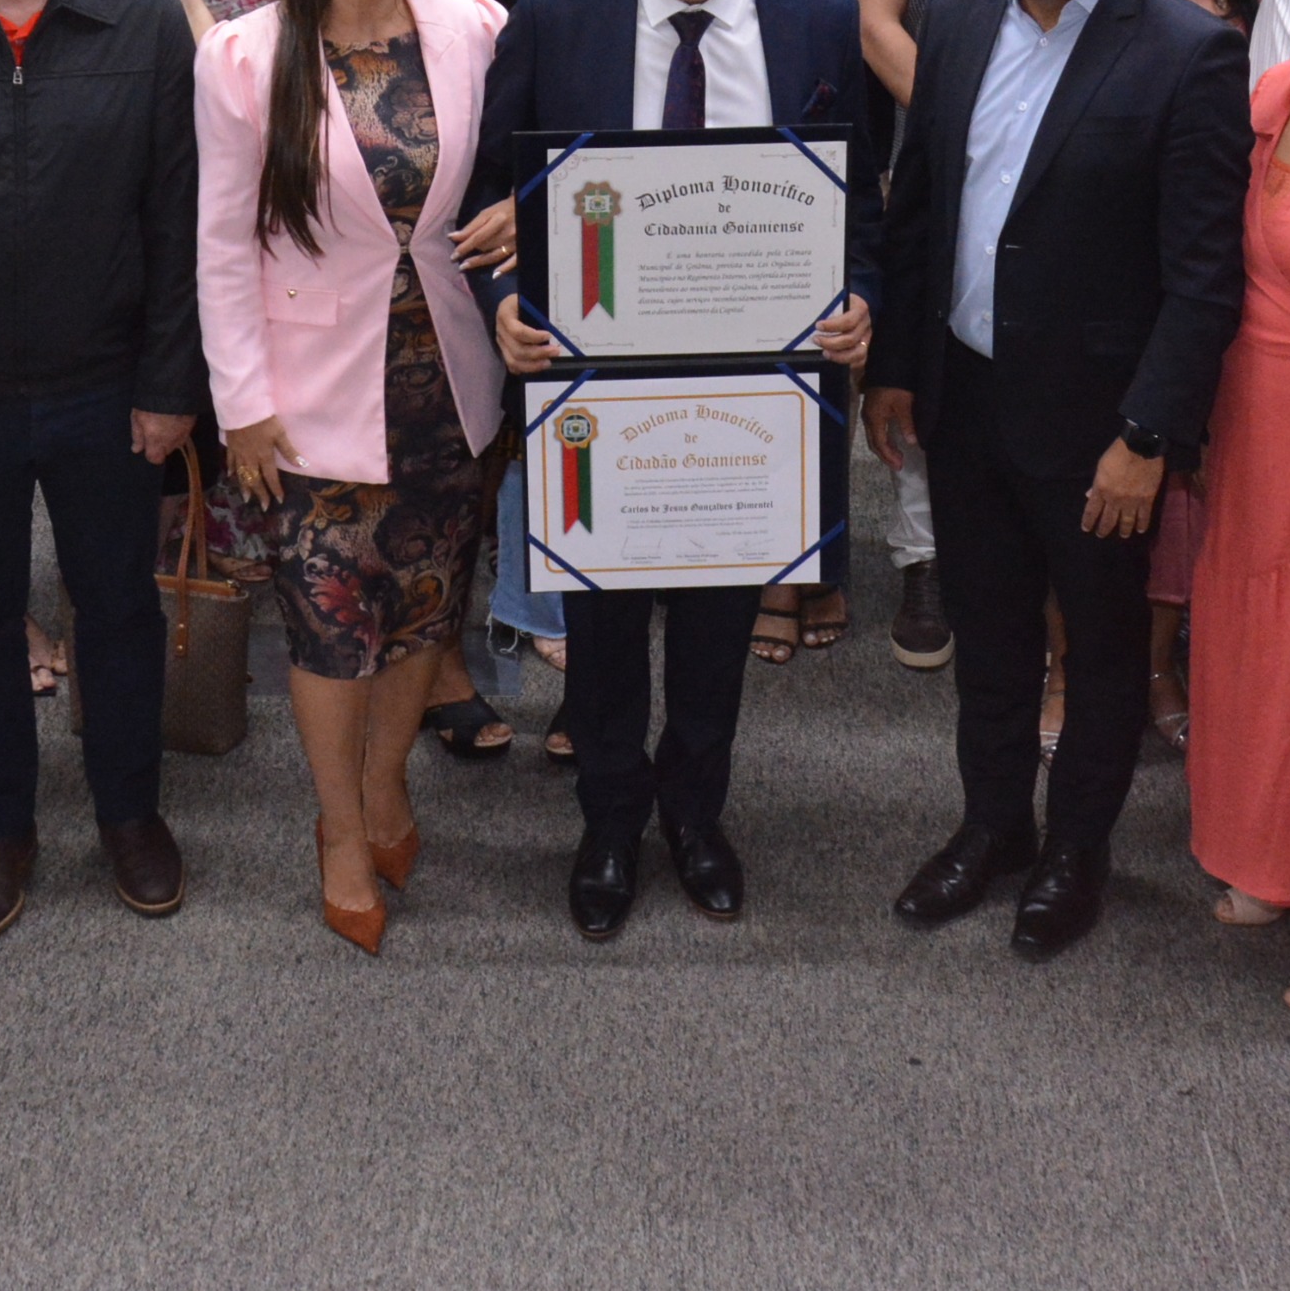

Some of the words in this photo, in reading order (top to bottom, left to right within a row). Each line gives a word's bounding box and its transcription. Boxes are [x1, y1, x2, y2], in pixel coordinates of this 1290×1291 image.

[634, 180, 715, 212] Diploma
[721, 175, 815, 206] Honorífico
[718, 203, 732, 213] de
[644, 222, 717, 237] Cidadania
[722, 221, 804, 234] Goianiense
[619, 409, 689, 443] Diploma
[694, 404, 774, 444] Honorífico
[684, 433, 698, 444] de
[616, 454, 677, 471] Cidadão
[682, 453, 767, 469] Goianiense
[620, 505, 649, 514] Carlos
[651, 505, 660, 513] de
[662, 503, 688, 514] Jesus
[736, 500, 774, 511] Pimentel
